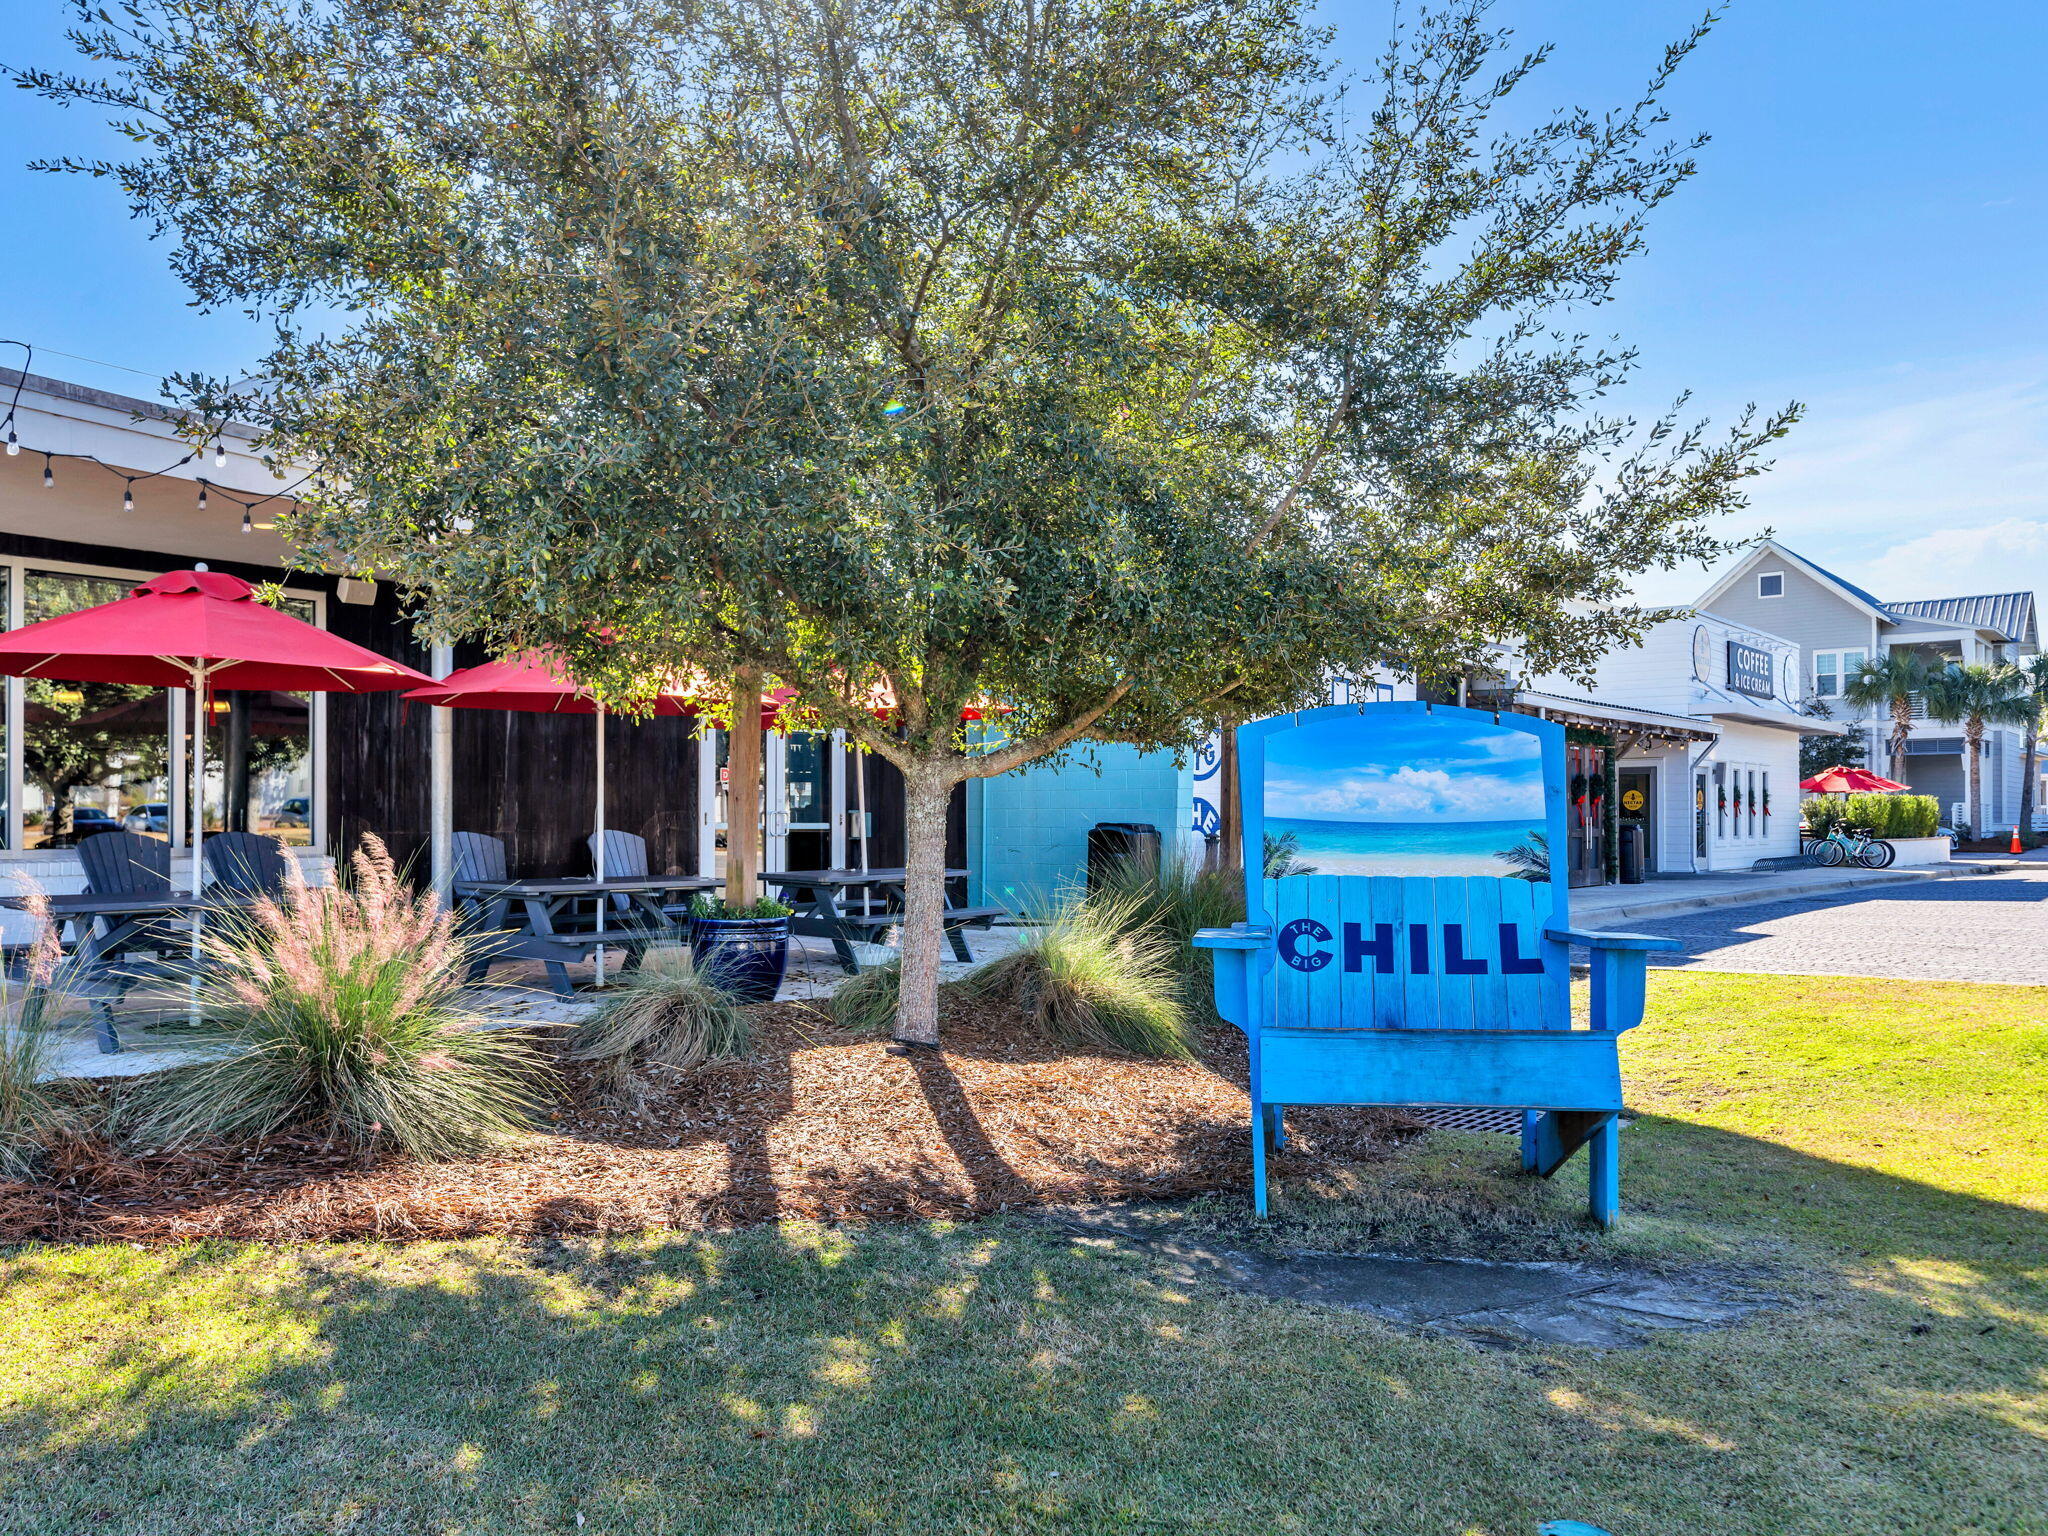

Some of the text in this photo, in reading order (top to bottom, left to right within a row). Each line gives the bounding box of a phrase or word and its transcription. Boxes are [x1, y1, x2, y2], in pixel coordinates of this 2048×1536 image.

[1737, 647, 1769, 676] COFFEE
[1735, 672, 1771, 695] & ICE CREAM
[1195, 742, 1216, 771] IG
[1192, 802, 1217, 834] HE
[1289, 922, 1324, 938] THE
[1278, 918, 1546, 975] CHILL
[1290, 955, 1322, 969] BIG
